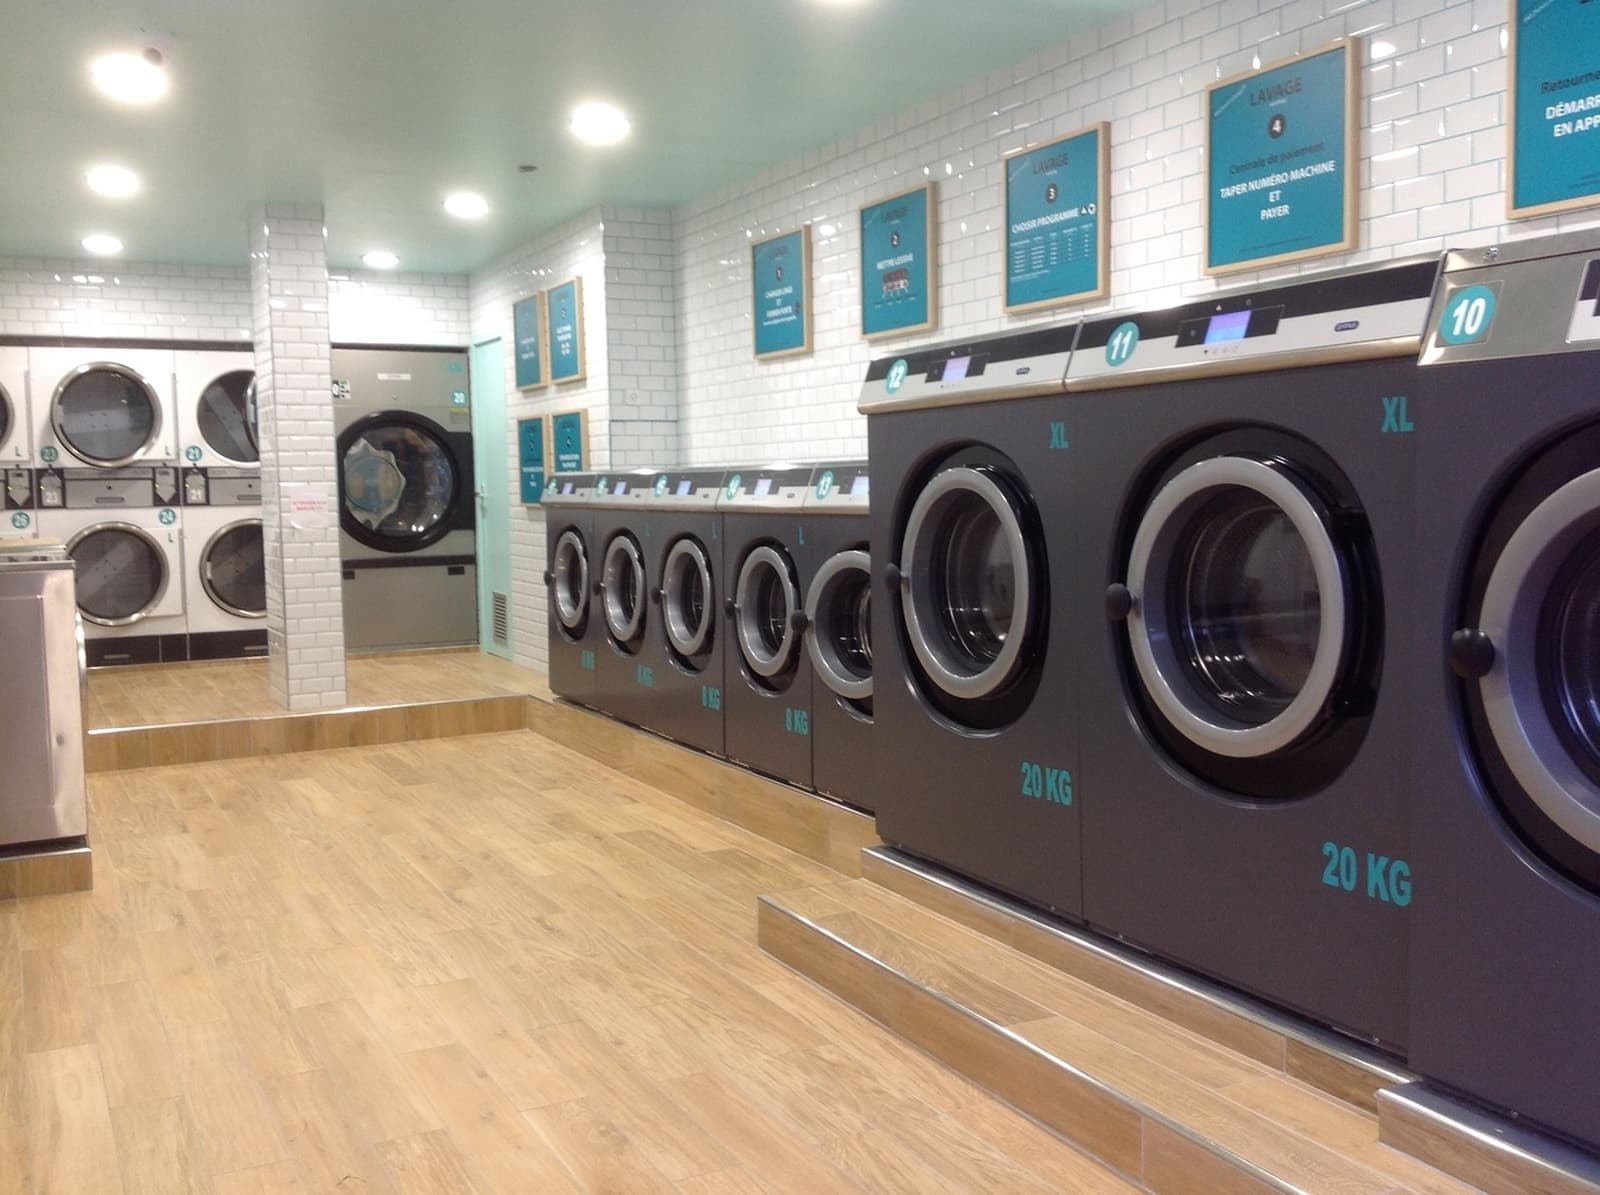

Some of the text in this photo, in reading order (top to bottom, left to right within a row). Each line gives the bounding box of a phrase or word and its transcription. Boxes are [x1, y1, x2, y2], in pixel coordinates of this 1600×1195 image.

[1249, 77, 1303, 107] LAVAGE
[1271, 119, 1281, 133] 4
[1553, 121, 1573, 137] EN
[1220, 160, 1336, 199] TAPER NUMÉRO MACHINE
[1269, 190, 1281, 202] ET
[1260, 204, 1290, 221] PAYER
[1453, 297, 1486, 335] 10
[1111, 330, 1132, 360] 11
[889, 364, 904, 389] 12
[1381, 396, 1415, 433] XL
[1049, 421, 1069, 449] XL
[794, 709, 808, 736] KG
[1021, 762, 1073, 807] 20 KG
[1321, 841, 1412, 907] 20 KG
